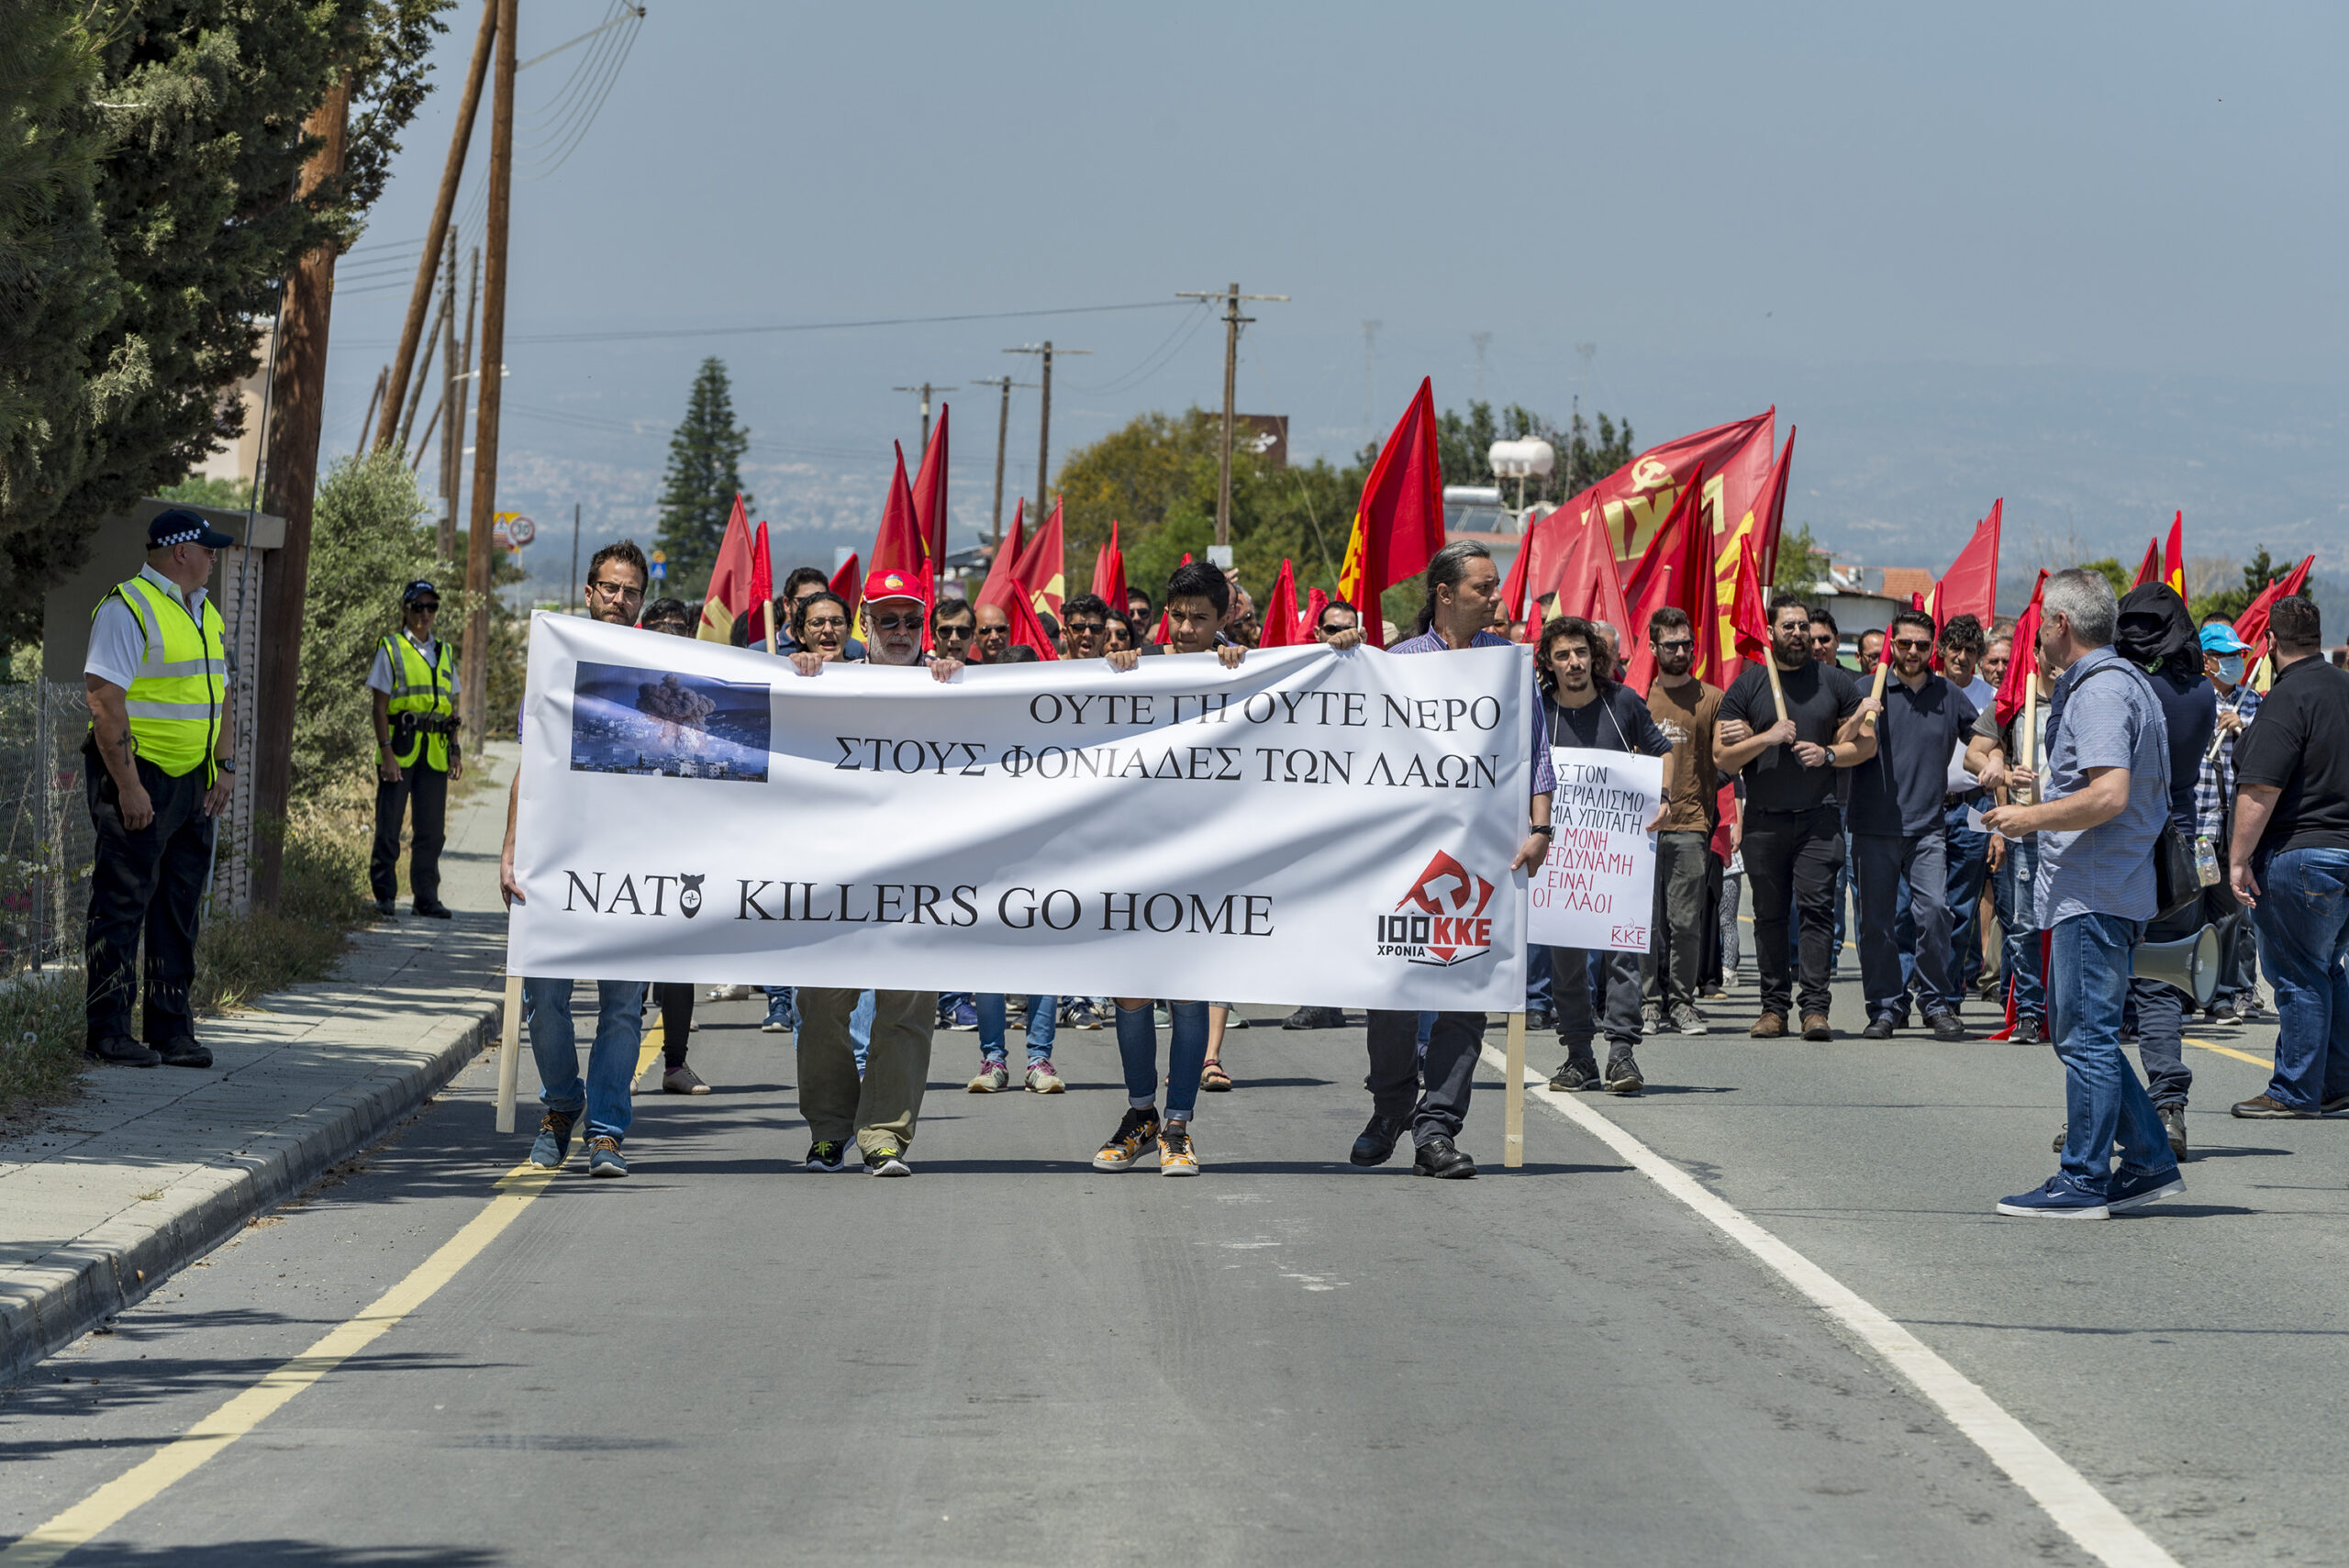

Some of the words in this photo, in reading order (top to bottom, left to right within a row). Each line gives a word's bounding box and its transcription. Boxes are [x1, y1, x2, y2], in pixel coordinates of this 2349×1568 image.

[1030, 693, 1154, 725] ΟΥΤΕ
[1169, 692, 1231, 725] ΓΗ
[1243, 690, 1367, 726] ΟΥΤΕ
[1380, 693, 1501, 732] ΝΕΡΟ
[834, 737, 986, 777] ΣΤΟΥΣ
[1000, 745, 1242, 781] ΦΟΝΙΑΔΕΣ
[1255, 748, 1354, 785] ΤΩΝ
[1364, 753, 1500, 790] ΛΑΩΝ
[1578, 807, 1643, 836] ΥΠΟΤΑΓΗ
[1564, 828, 1609, 851] ΜΟΝΗ
[1548, 871, 1594, 892] ΕΙΝΑΙ
[734, 879, 978, 929] KILLERS
[996, 886, 1082, 929] GO
[1097, 891, 1275, 938] HOME
[1564, 891, 1612, 914] ΛΑΟΙ
[1377, 945, 1426, 957] ΧΡΟΝΙΑ
